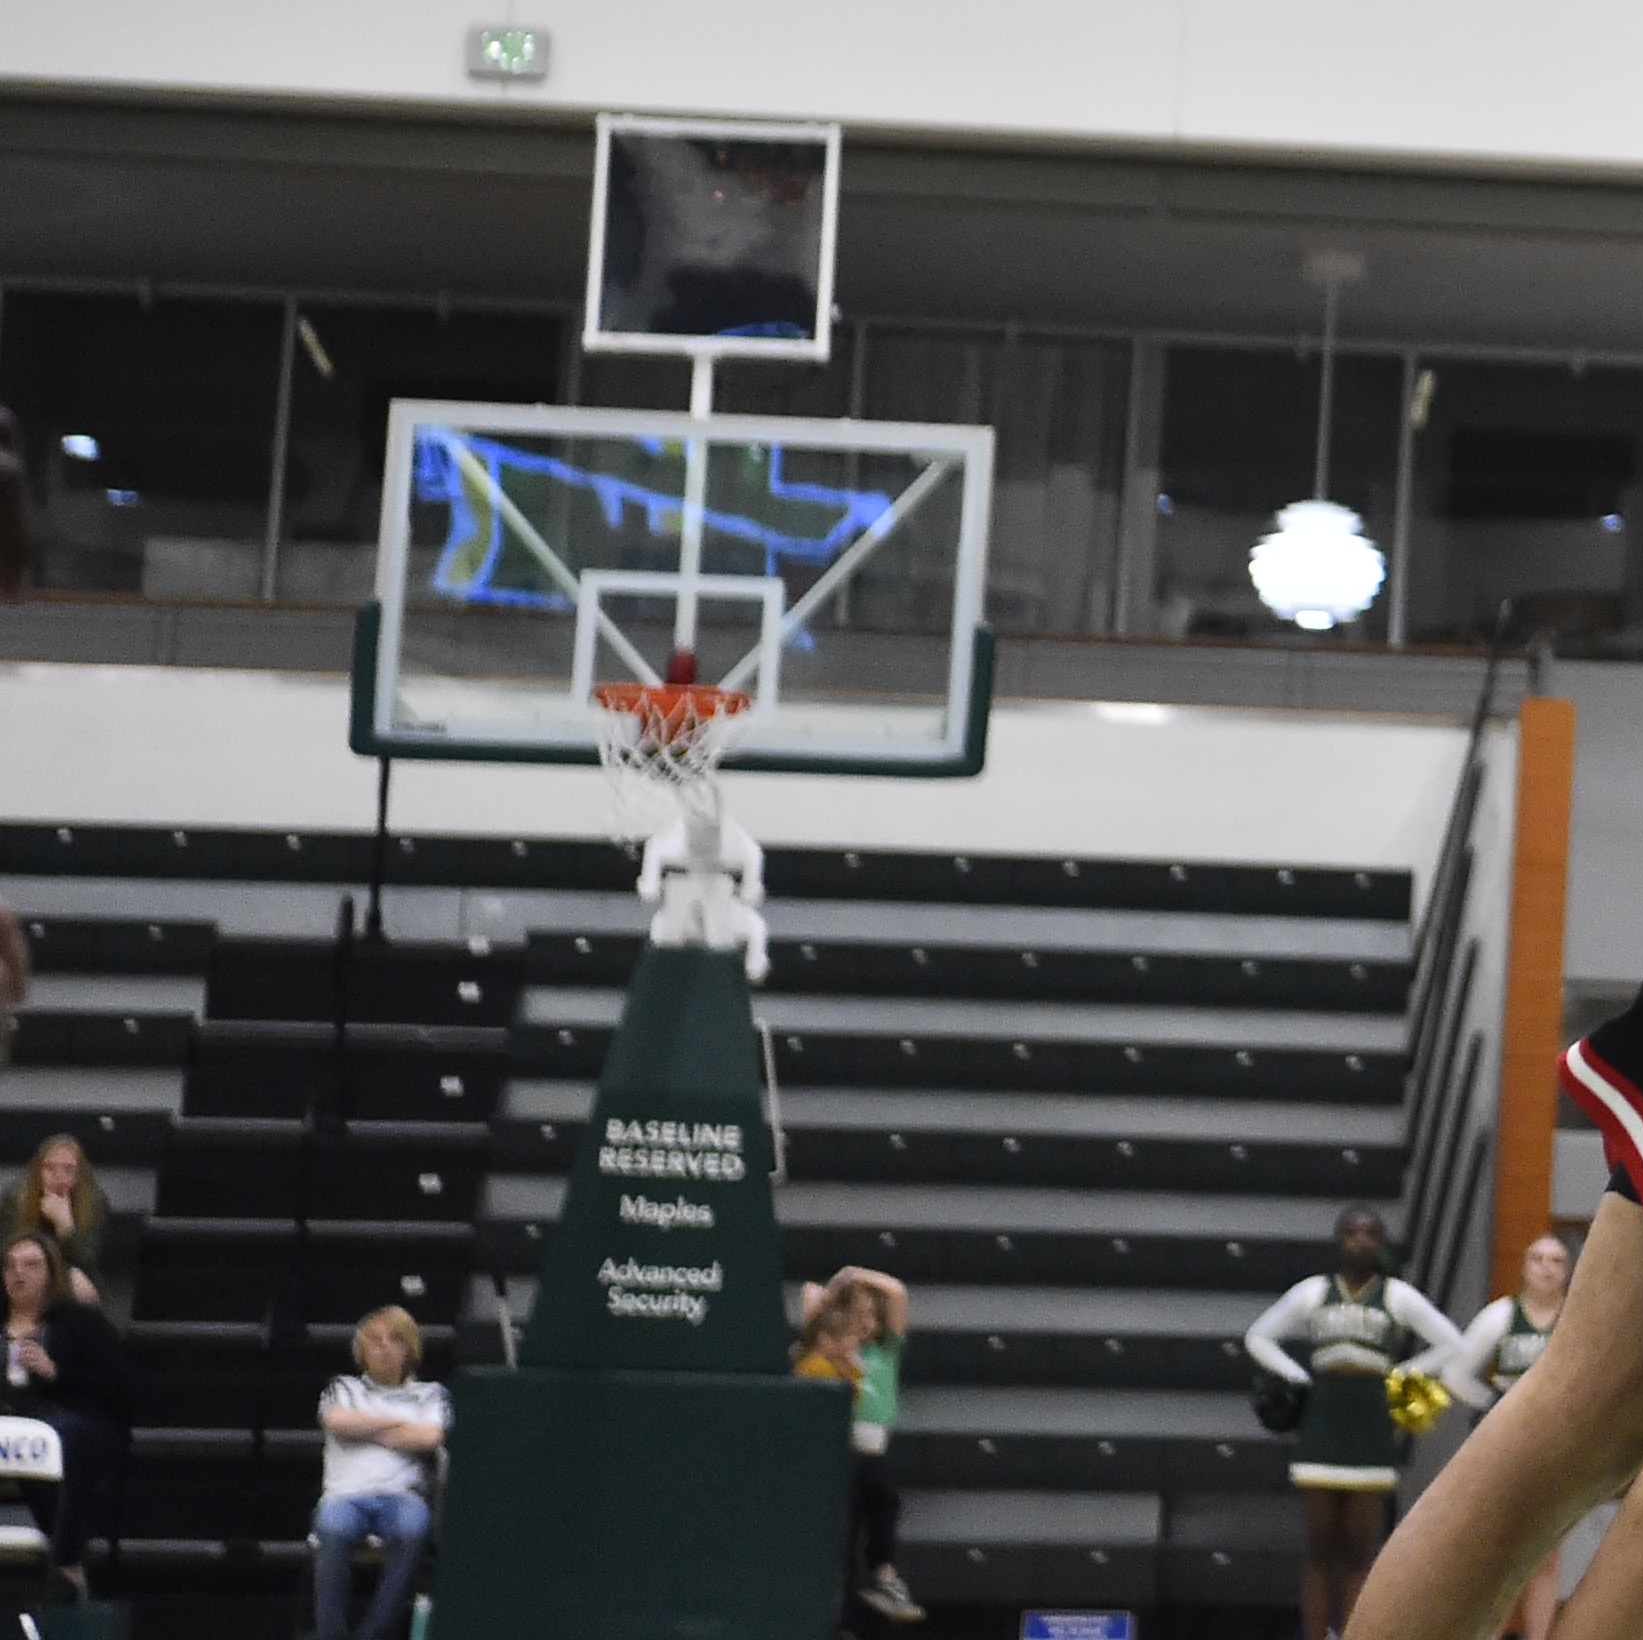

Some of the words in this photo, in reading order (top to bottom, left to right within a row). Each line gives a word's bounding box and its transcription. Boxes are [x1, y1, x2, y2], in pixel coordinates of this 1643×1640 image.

[606, 1118, 743, 1152] BASELINE
[599, 1147, 746, 1182] RESERVED
[619, 1193, 716, 1232] Maples
[598, 1256, 723, 1292] Advanced
[606, 1285, 709, 1326] Security
